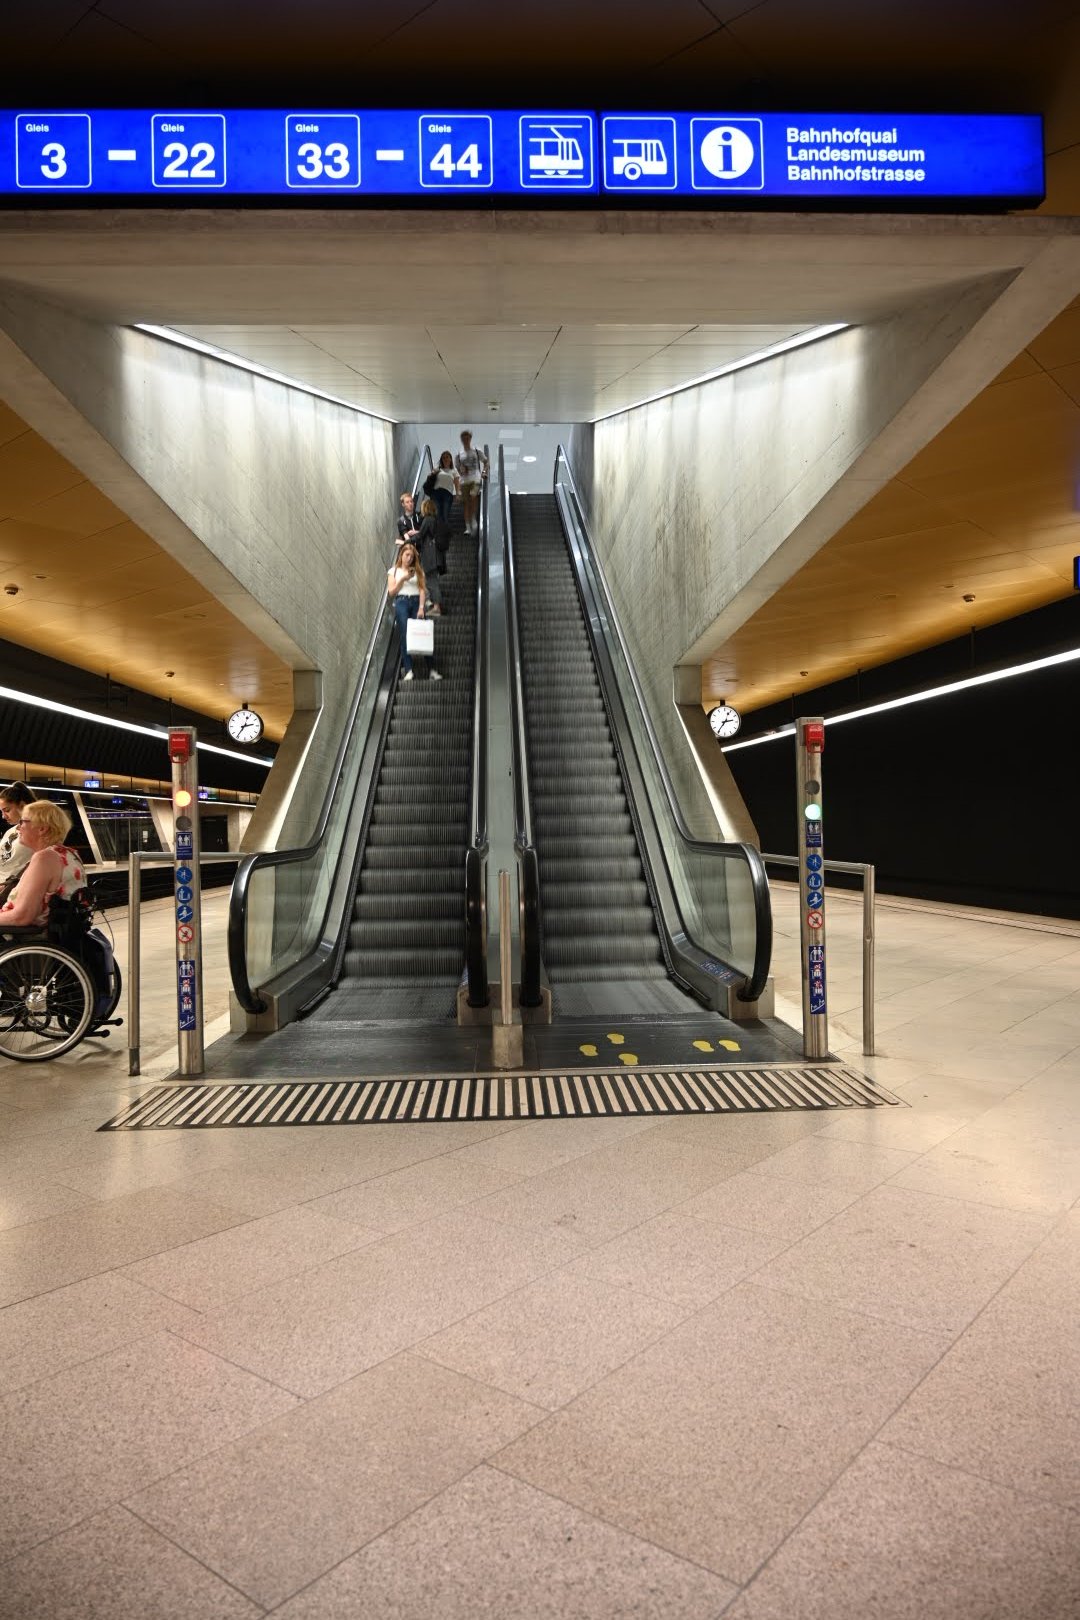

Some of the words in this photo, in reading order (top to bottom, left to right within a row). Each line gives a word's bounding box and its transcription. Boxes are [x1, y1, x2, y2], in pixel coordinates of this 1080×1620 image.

[25, 123, 50, 133] Gleis
[160, 123, 185, 133] Gleis
[295, 123, 320, 133] Gleis
[428, 124, 453, 133] Gleis
[786, 127, 898, 147] Bahnhofquai
[40, 142, 68, 180] 3
[163, 142, 216, 178] 22
[296, 142, 351, 180] 33
[429, 143, 484, 179] 44
[786, 145, 926, 162] Landesmuseum
[787, 165, 926, 182] Bahnhofstrasse
